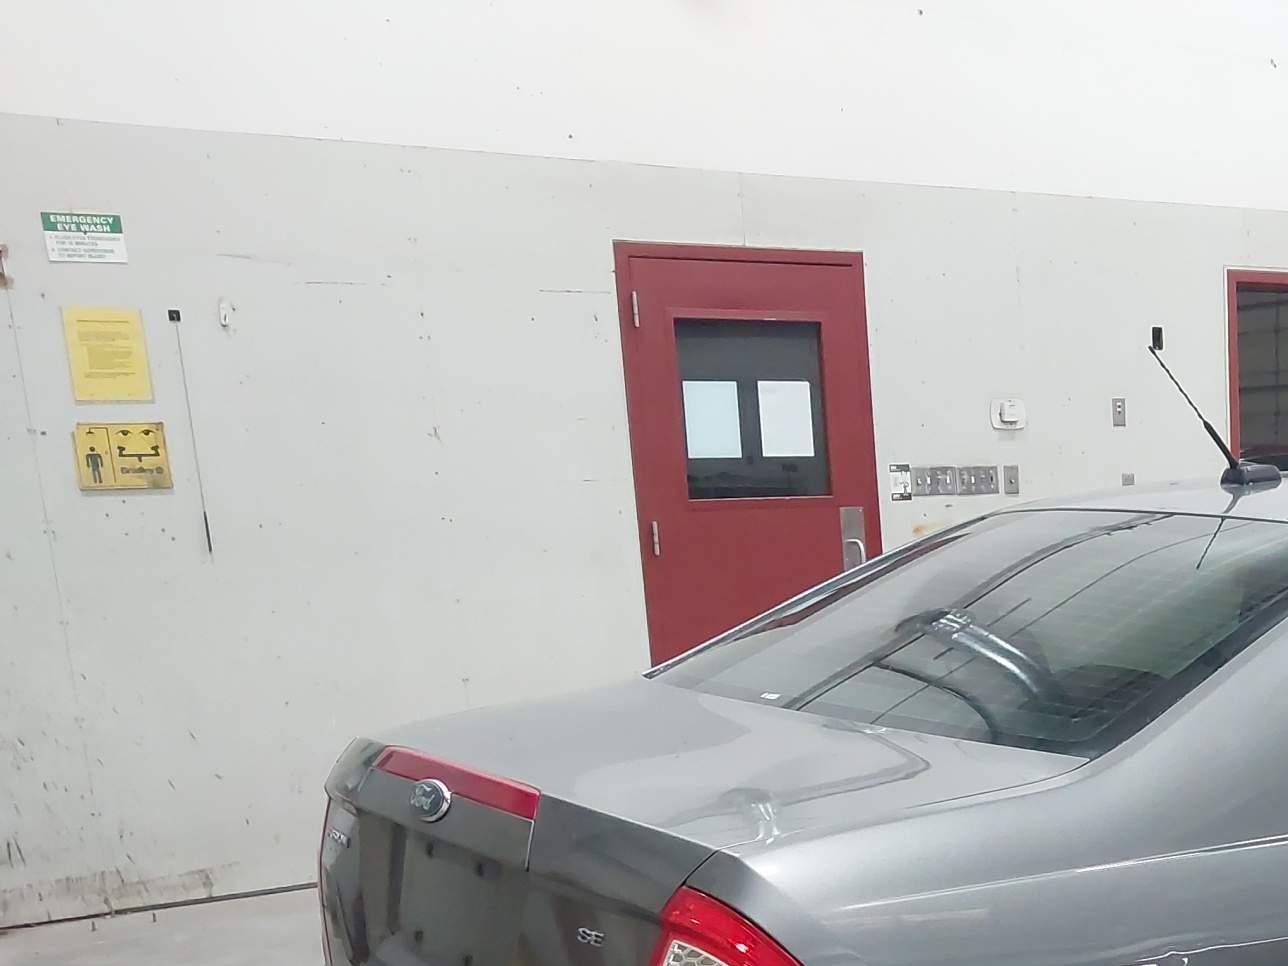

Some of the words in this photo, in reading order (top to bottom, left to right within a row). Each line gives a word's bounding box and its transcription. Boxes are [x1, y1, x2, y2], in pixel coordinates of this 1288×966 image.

[49, 214, 114, 224] EMERGENCY
[56, 223, 78, 231] EYE
[80, 224, 112, 232] WASH
[577, 927, 605, 947] SE
